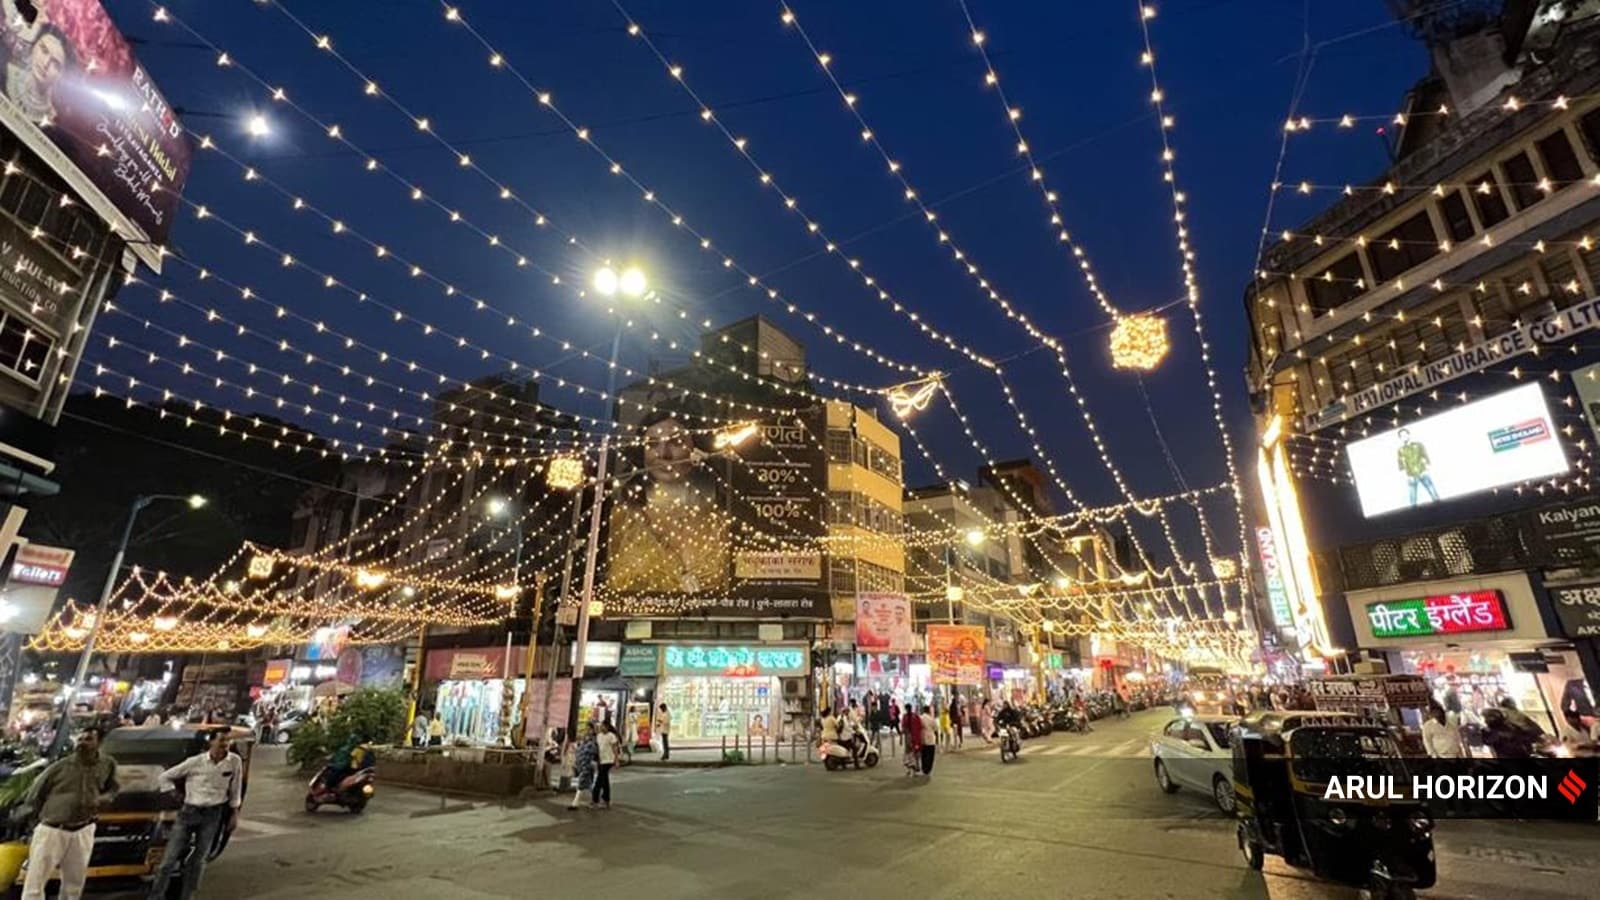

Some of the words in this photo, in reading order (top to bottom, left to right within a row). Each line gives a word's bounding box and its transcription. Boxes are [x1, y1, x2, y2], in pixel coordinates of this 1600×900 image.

[1353, 373, 1423, 412] NATIONAL
[1425, 332, 1525, 384] INSURANCE
[1368, 603, 1420, 632] पीटर
